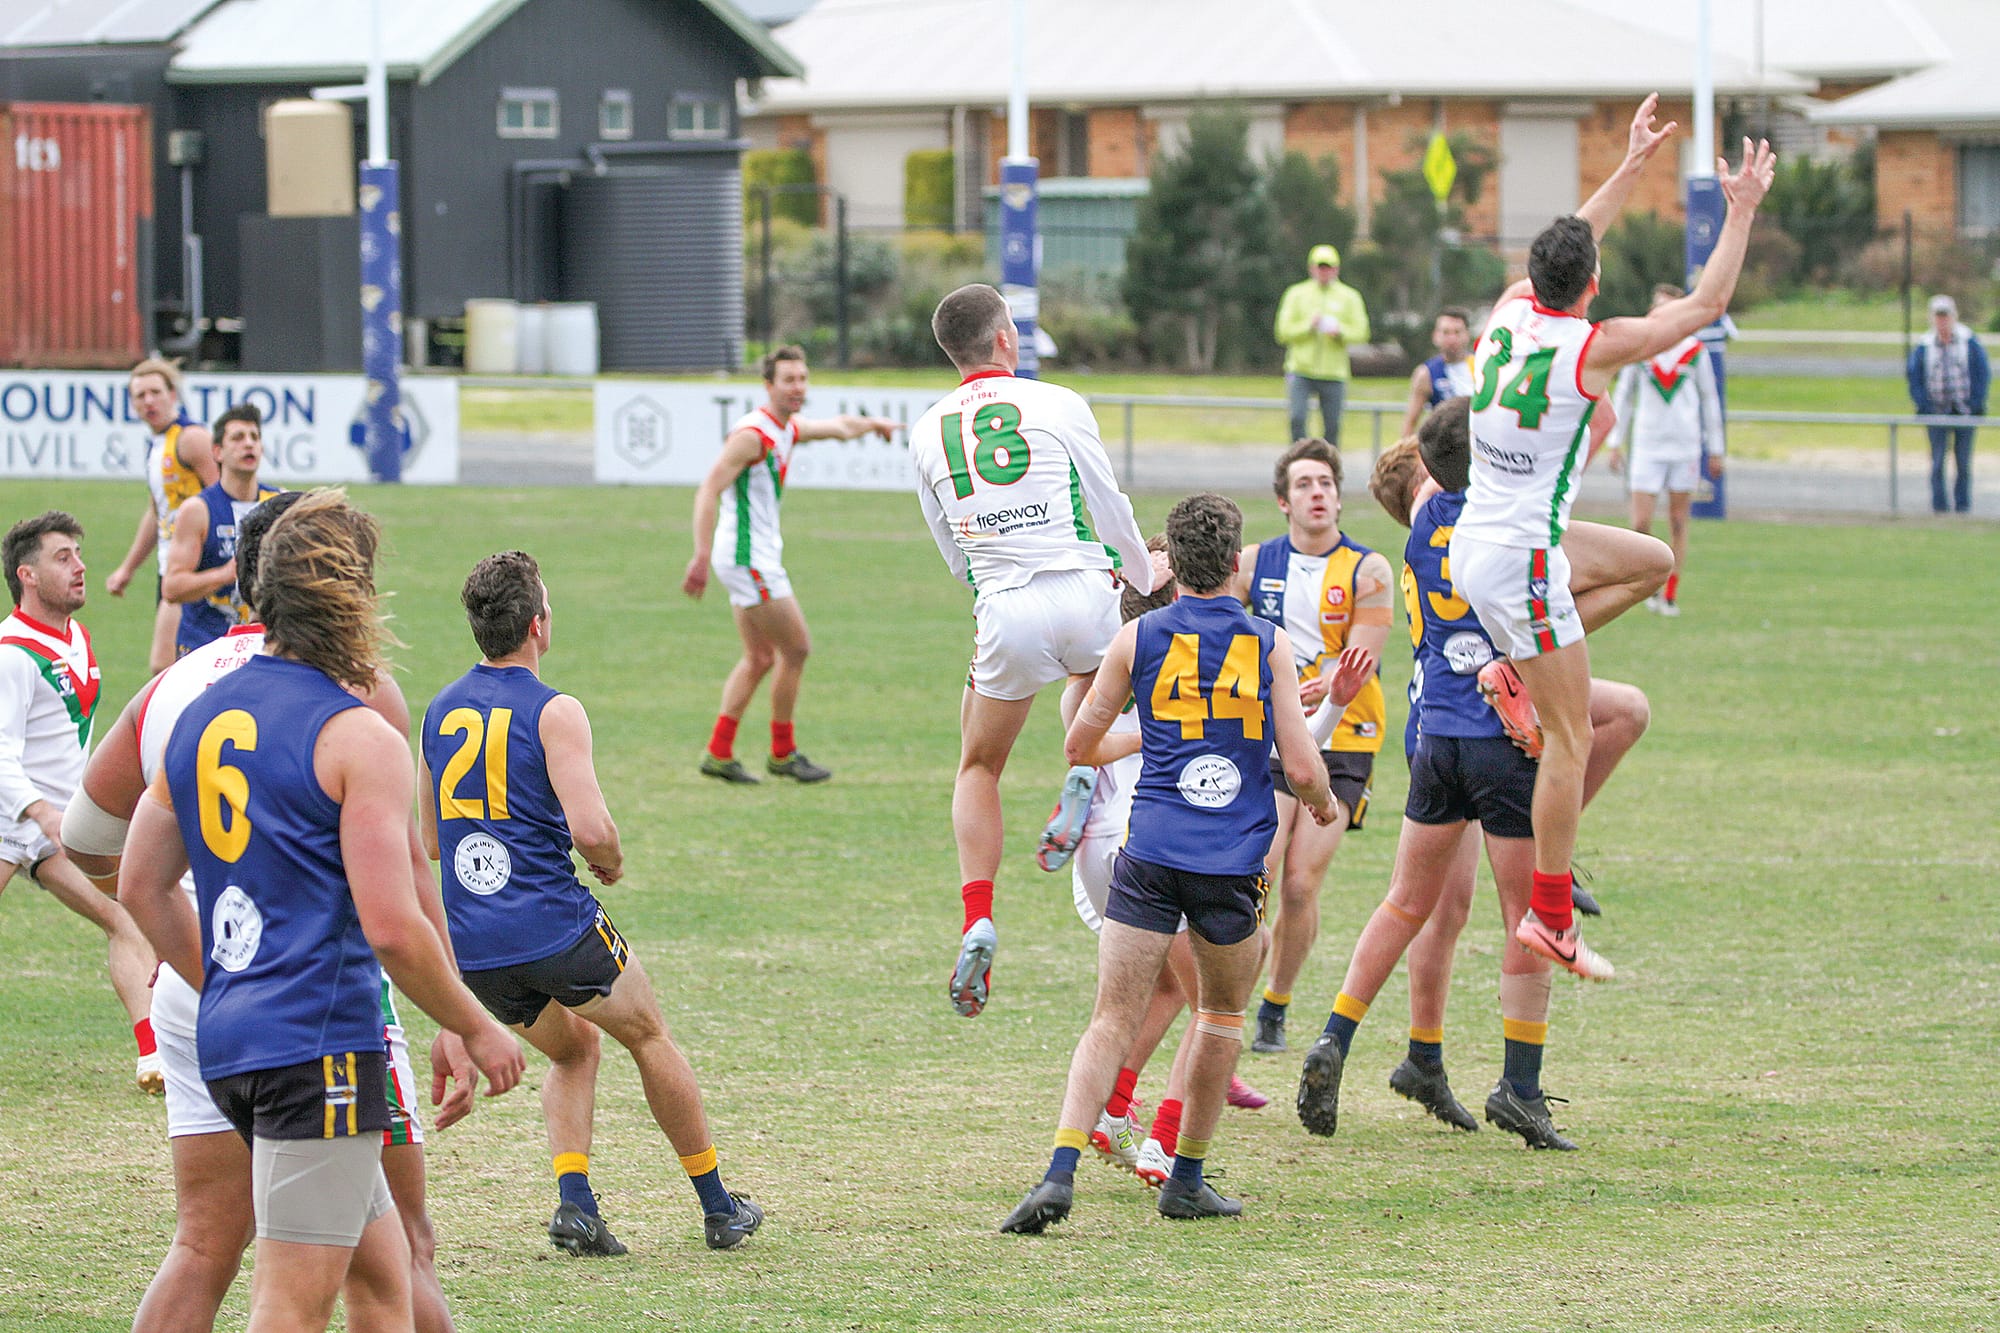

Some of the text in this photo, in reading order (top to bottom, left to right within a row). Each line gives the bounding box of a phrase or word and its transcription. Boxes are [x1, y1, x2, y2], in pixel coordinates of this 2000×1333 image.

[1470, 326, 1558, 430] 34
[941, 402, 1032, 501] 18
[976, 501, 1049, 530] freeway
[213, 657, 234, 668] EST
[1151, 633, 1266, 740] 44
[196, 708, 258, 864] 6
[438, 707, 513, 821] 21
[466, 841, 495, 853] THE INVY
